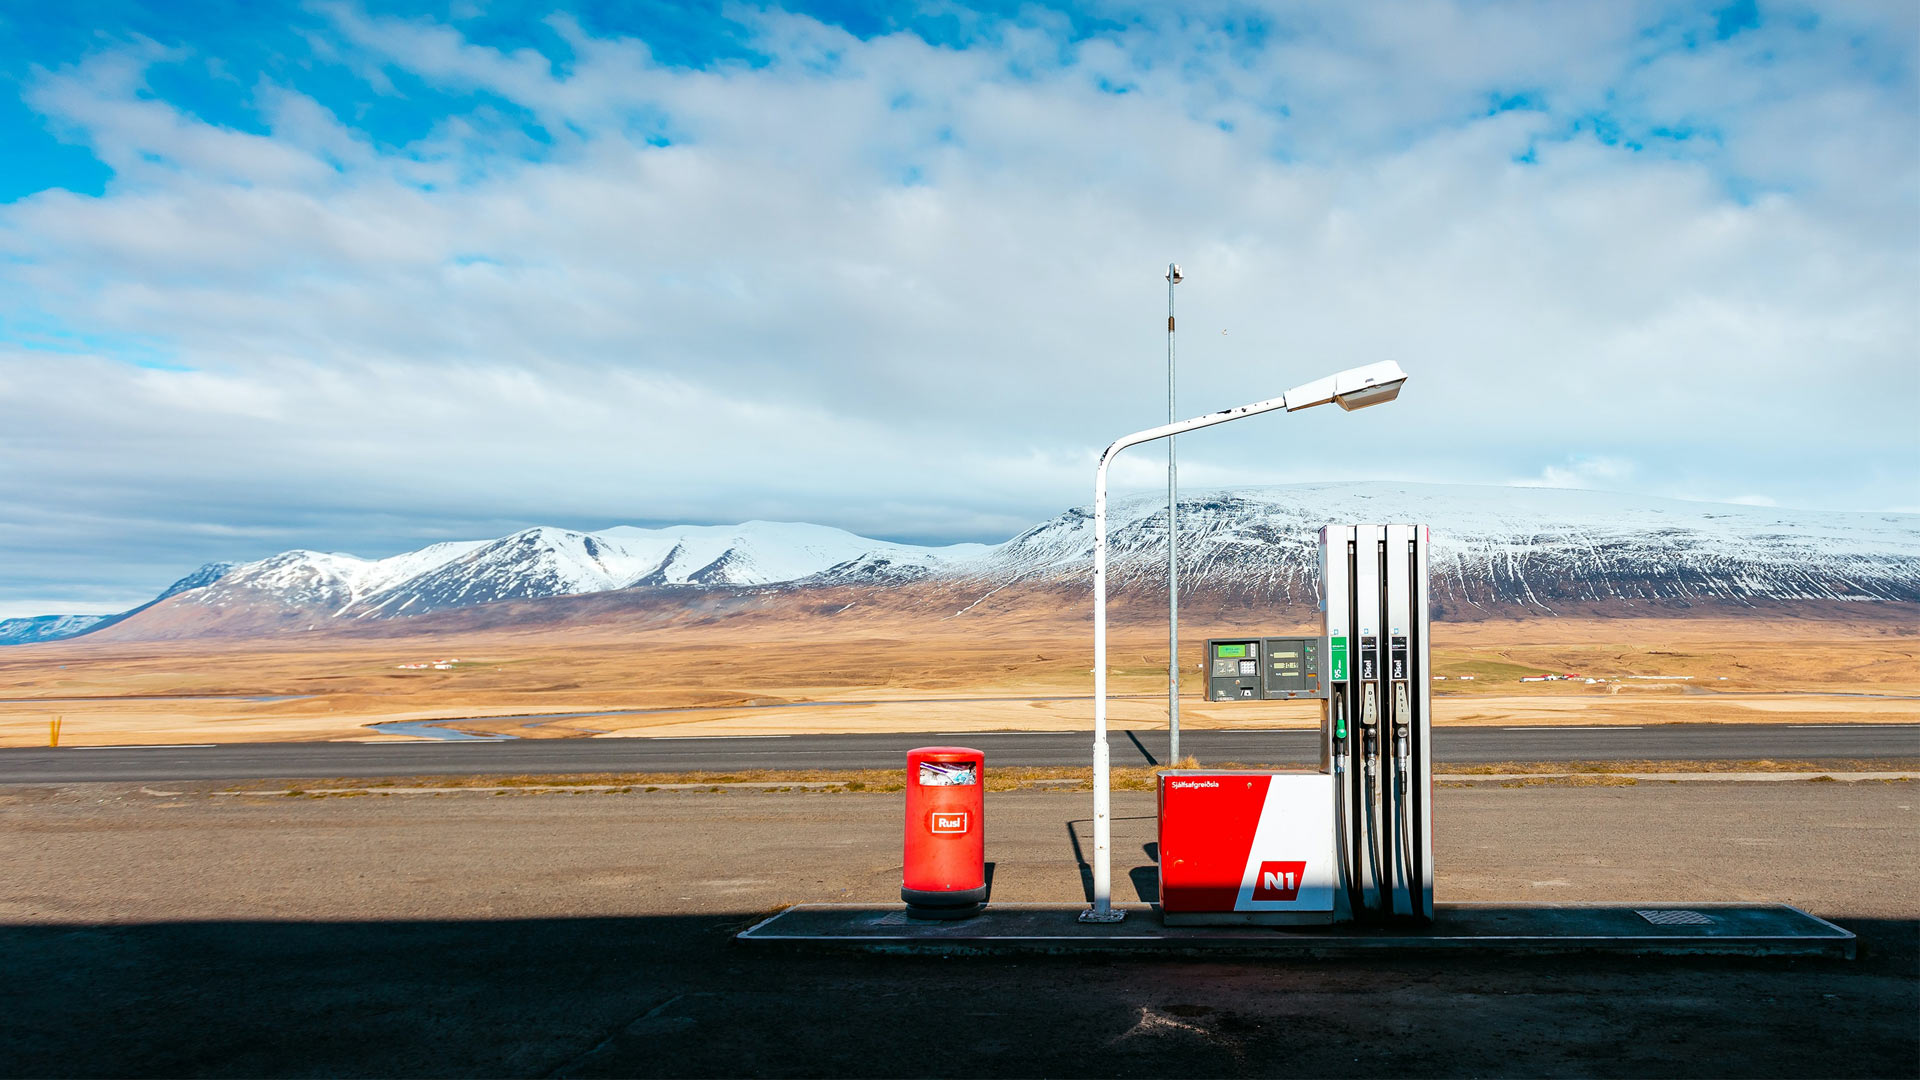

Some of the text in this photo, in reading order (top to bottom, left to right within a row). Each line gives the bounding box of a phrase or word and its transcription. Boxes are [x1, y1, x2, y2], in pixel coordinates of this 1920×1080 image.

[1334, 669, 1342, 679] 95
[939, 817, 960, 828] Rusl
[1264, 871, 1295, 890] N1
